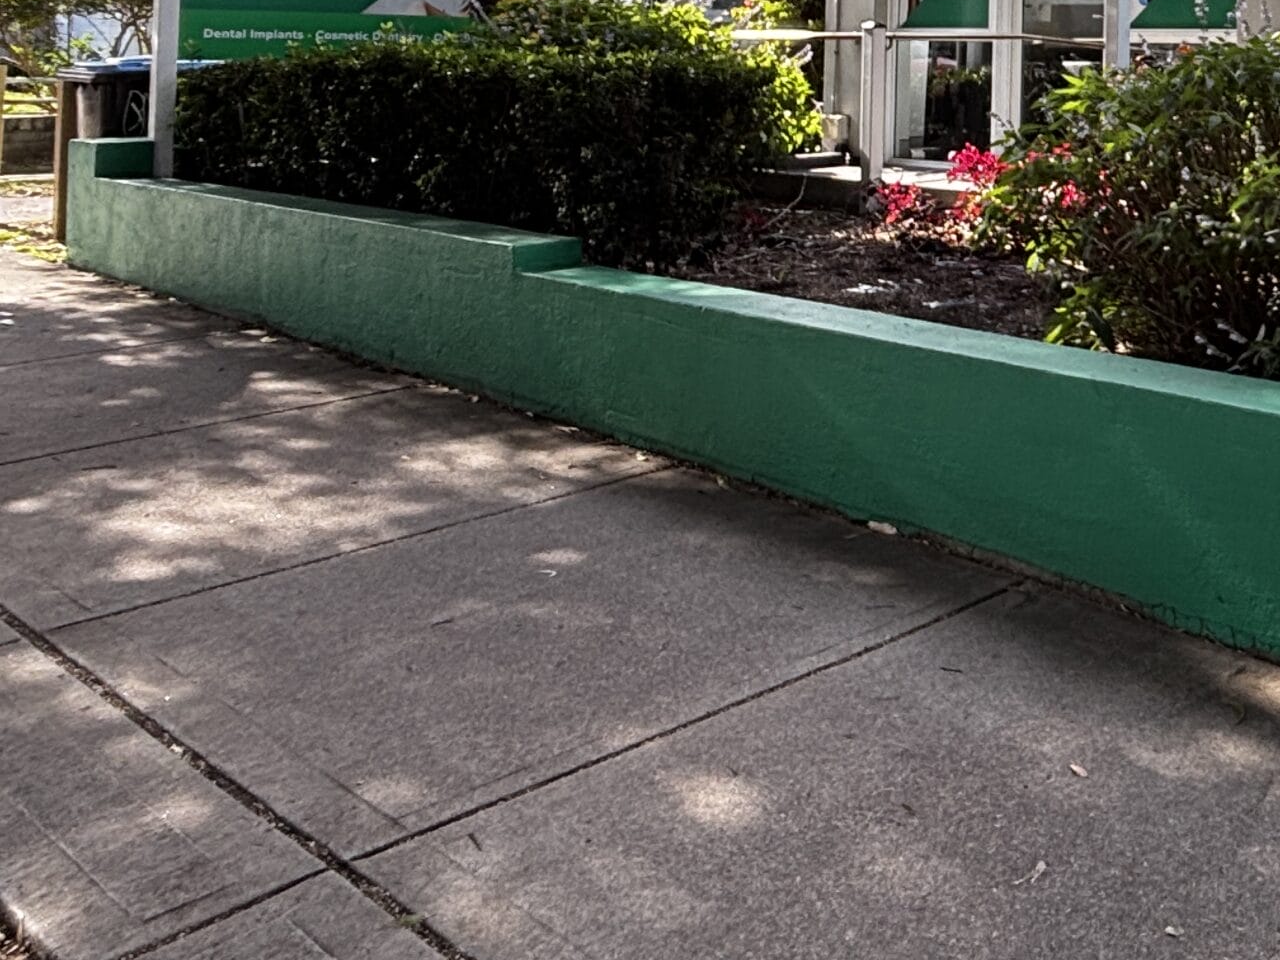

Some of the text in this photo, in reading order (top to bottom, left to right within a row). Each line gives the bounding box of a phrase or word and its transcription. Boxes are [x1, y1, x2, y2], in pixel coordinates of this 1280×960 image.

[203, 28, 246, 39] Dental
[250, 28, 304, 40] Implants
[315, 30, 369, 41] Cosmetic
